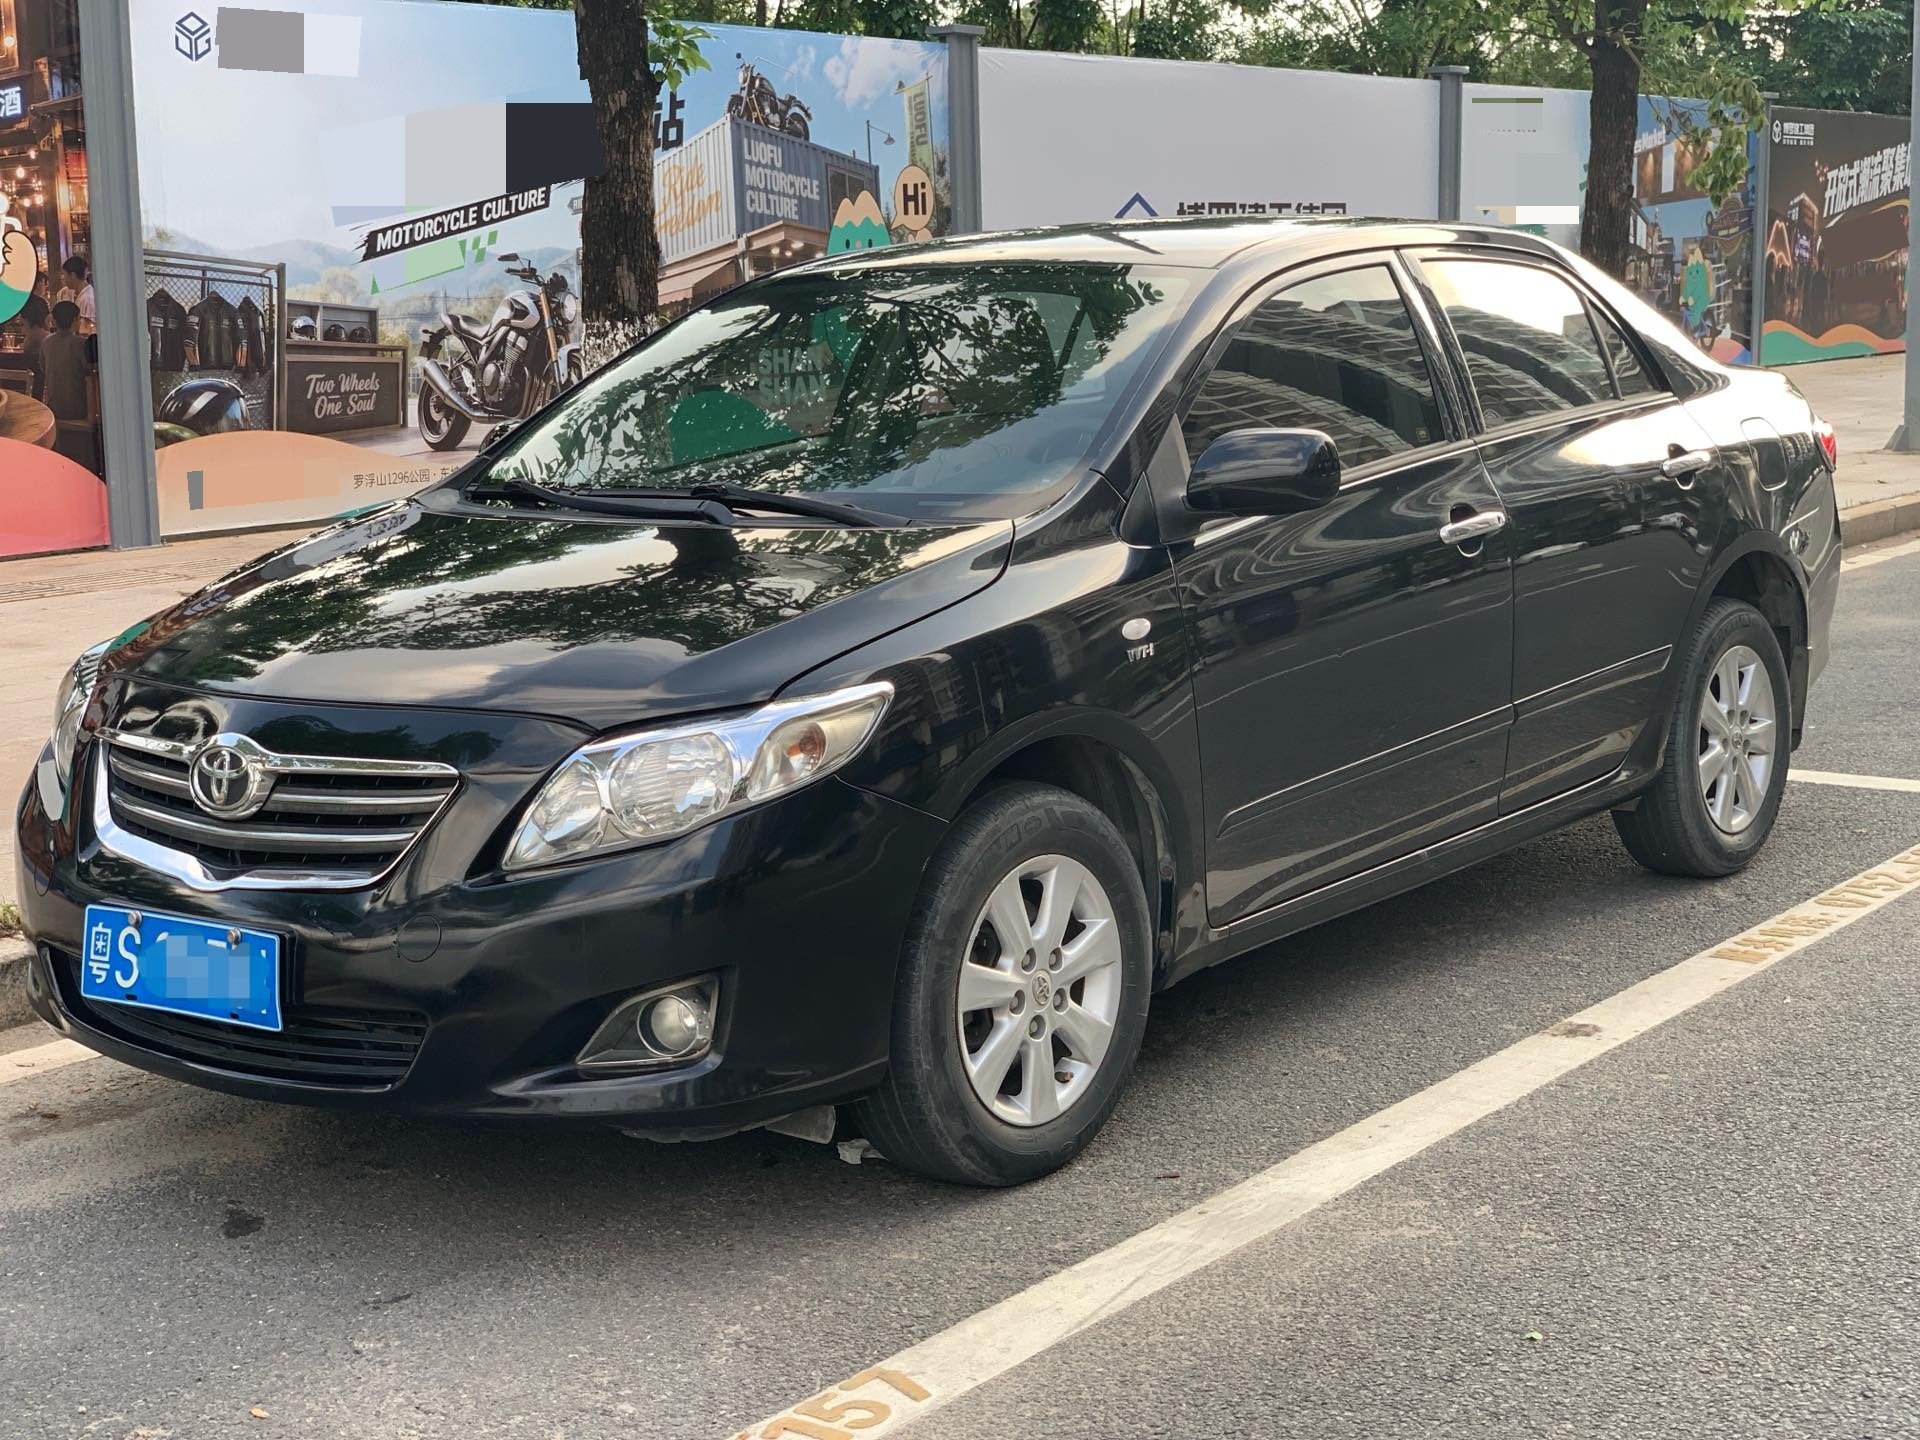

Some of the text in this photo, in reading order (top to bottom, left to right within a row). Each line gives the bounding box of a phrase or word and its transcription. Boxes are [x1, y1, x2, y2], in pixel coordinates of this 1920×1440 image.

[744, 137, 783, 168] LUOFU
[745, 165, 820, 200] MOTORCYCLE
[902, 181, 927, 216] Hi
[375, 186, 547, 253] MOTORCYCLE CULTURE
[746, 189, 800, 220] CULTURE
[305, 371, 380, 399] Two Wheels
[314, 393, 377, 419] One Soul
[736, 1366, 932, 1440] 157
